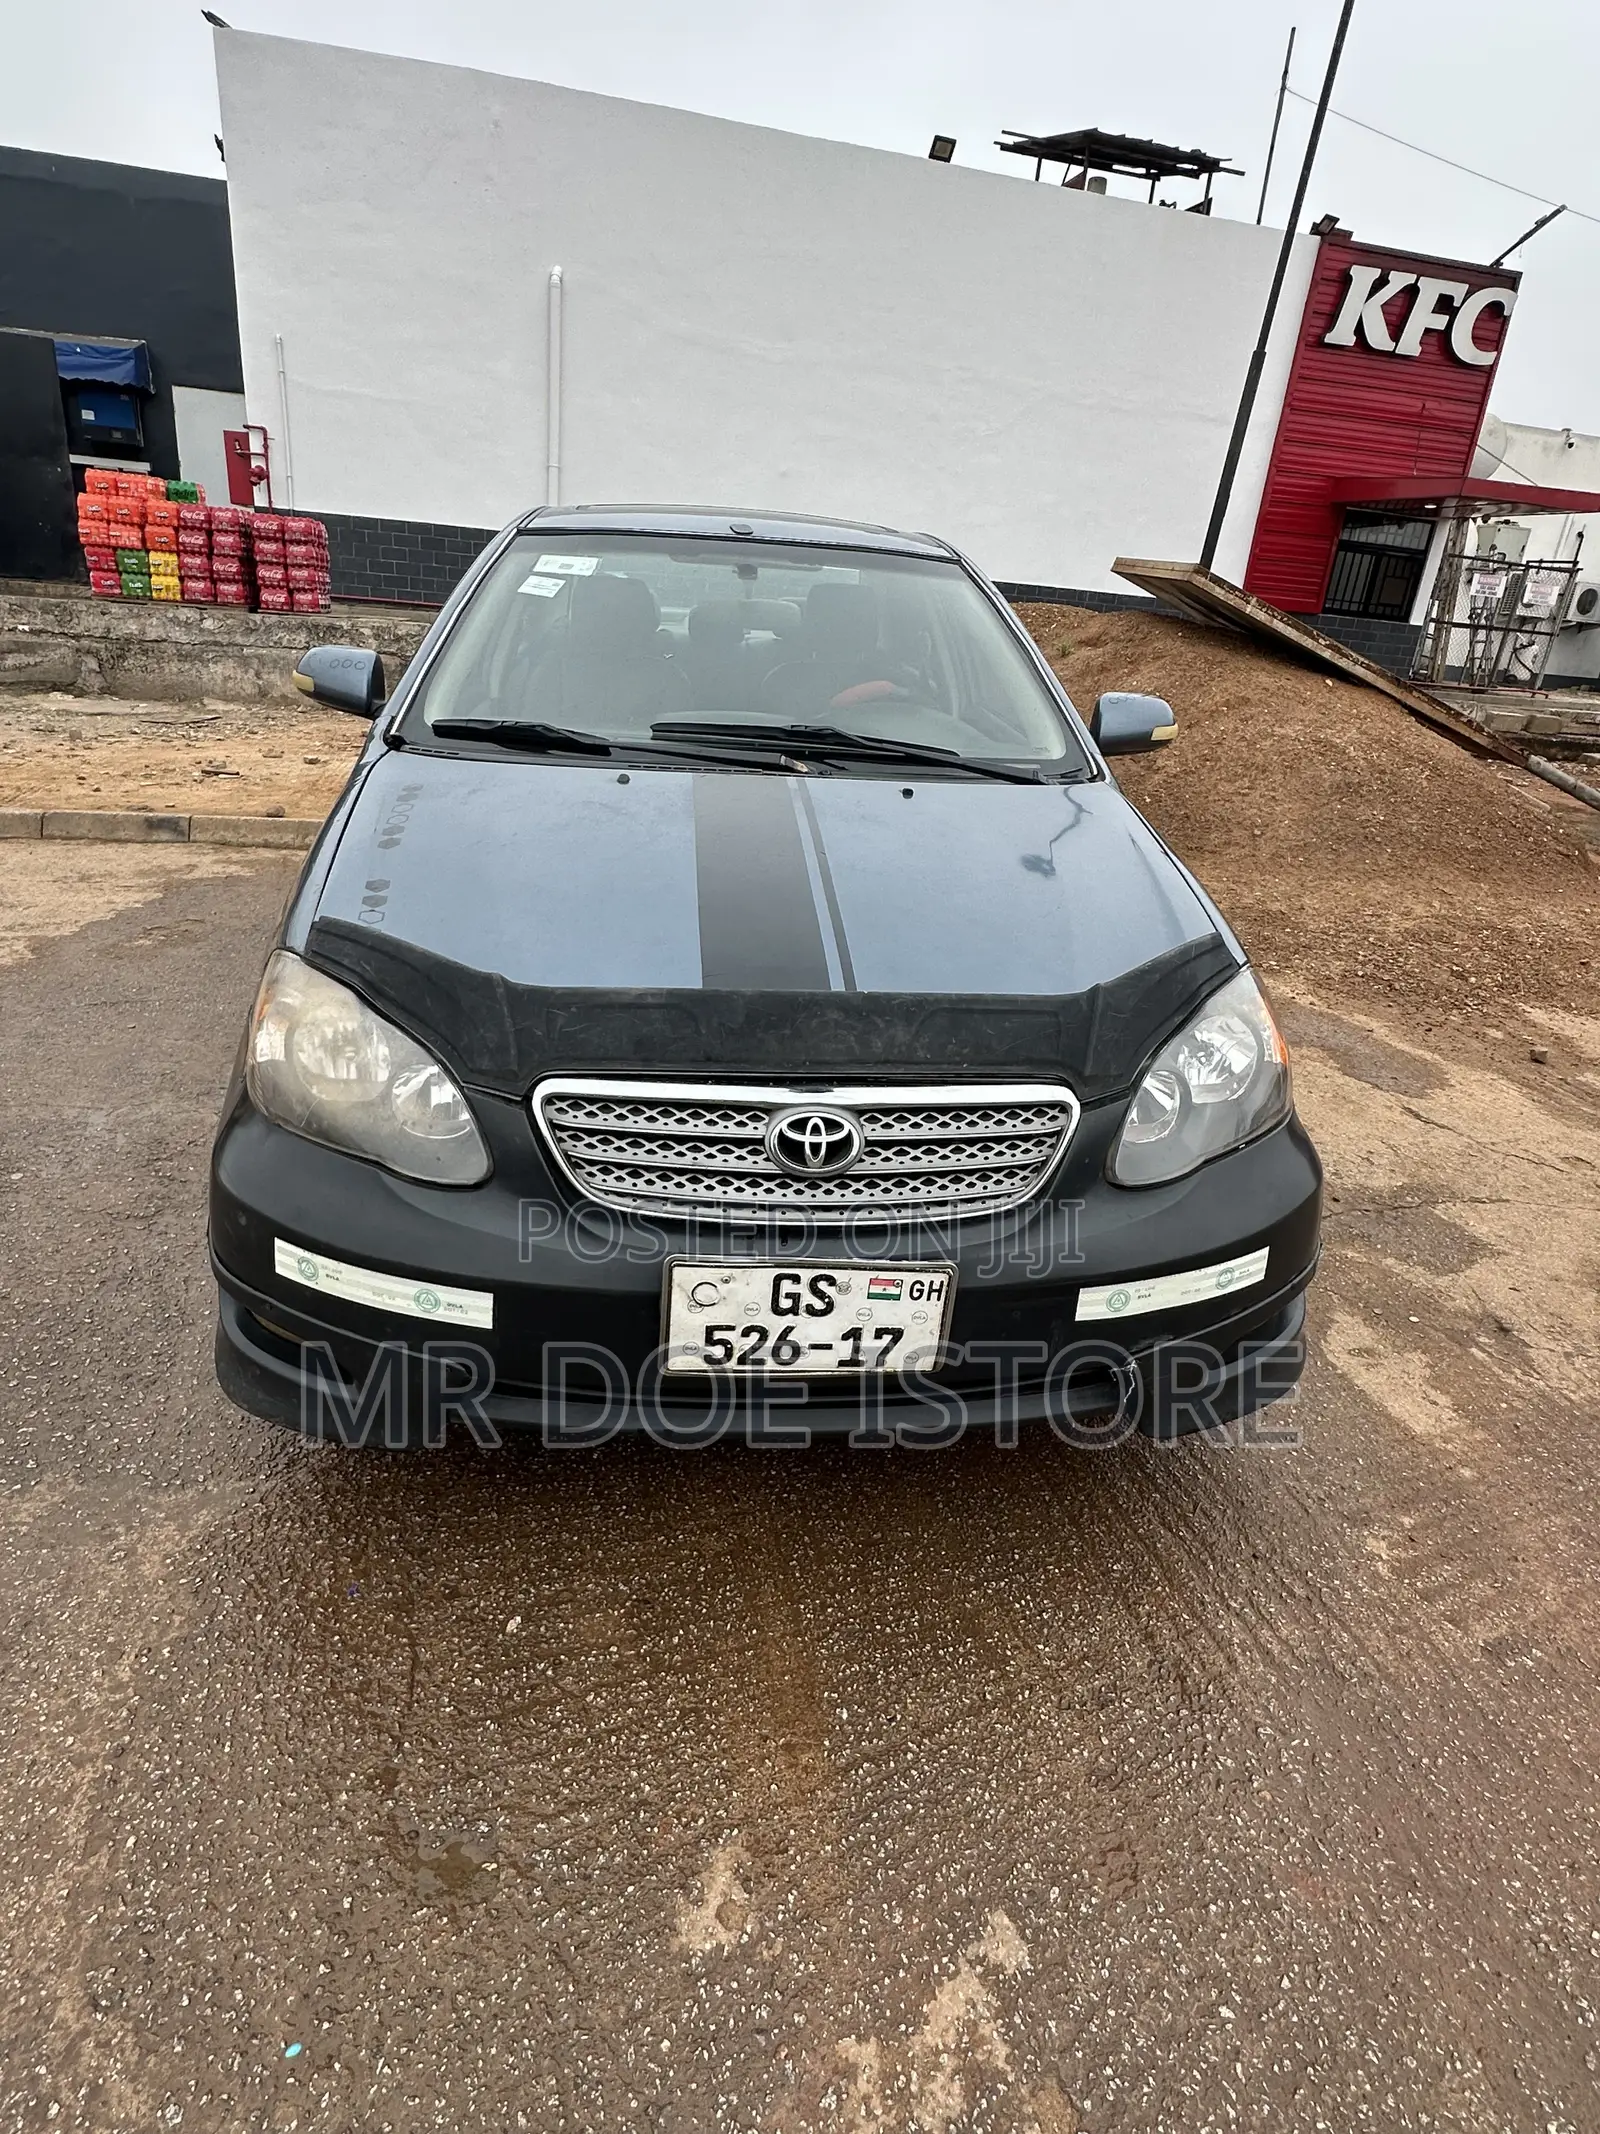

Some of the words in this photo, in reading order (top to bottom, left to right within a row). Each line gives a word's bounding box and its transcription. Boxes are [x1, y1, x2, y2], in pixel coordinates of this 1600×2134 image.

[1324, 265, 1519, 366] KFC
[770, 1272, 837, 1317] GS
[909, 1279, 945, 1302] GH
[703, 1323, 905, 1369] 526-17
